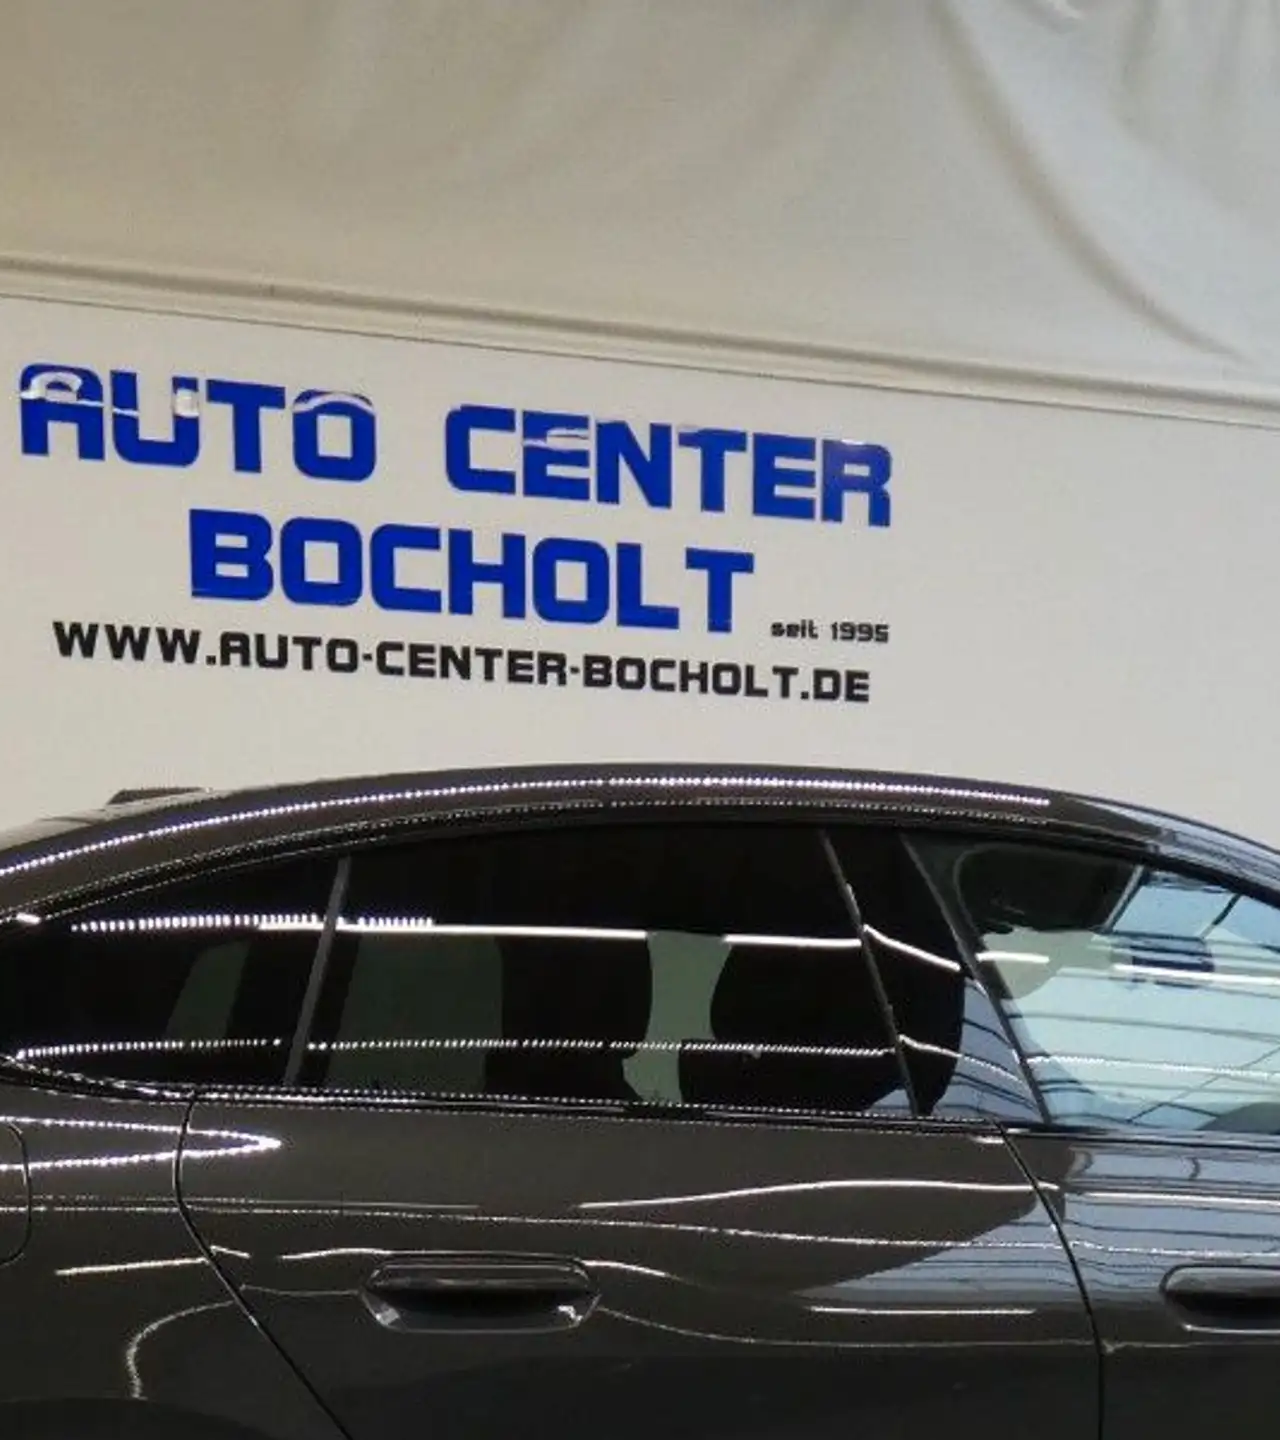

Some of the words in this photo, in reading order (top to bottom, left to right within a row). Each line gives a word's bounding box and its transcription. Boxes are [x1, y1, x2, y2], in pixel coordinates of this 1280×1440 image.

[19, 363, 377, 483] AUTO
[444, 404, 893, 528] CENTER
[189, 508, 756, 634] BOCHOLT
[52, 621, 870, 703] WWW.AUTO-CENTER-BOCHOLT.DE
[771, 619, 819, 639] seit
[831, 621, 889, 643] 1995
